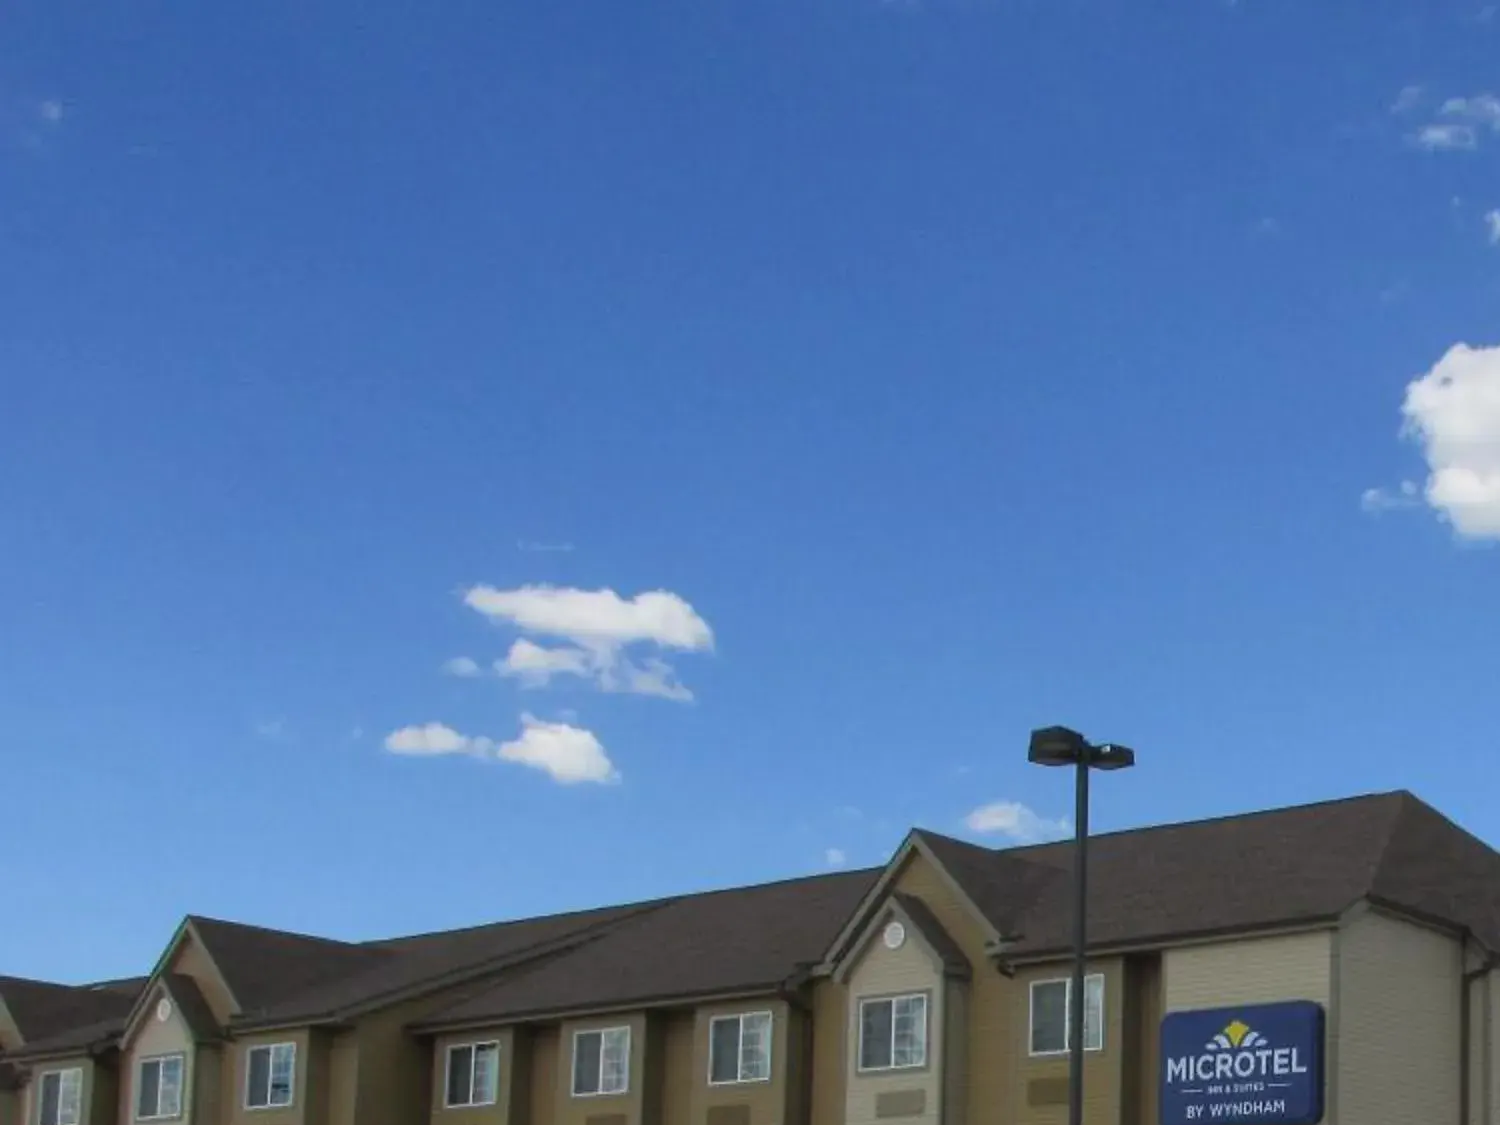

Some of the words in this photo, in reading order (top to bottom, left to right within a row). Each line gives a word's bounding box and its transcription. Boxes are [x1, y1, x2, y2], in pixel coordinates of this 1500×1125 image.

[1167, 1048, 1308, 1083] MICROTEL
[1186, 1103, 1204, 1119] BY
[1209, 1099, 1286, 1118] WYNDHAM
